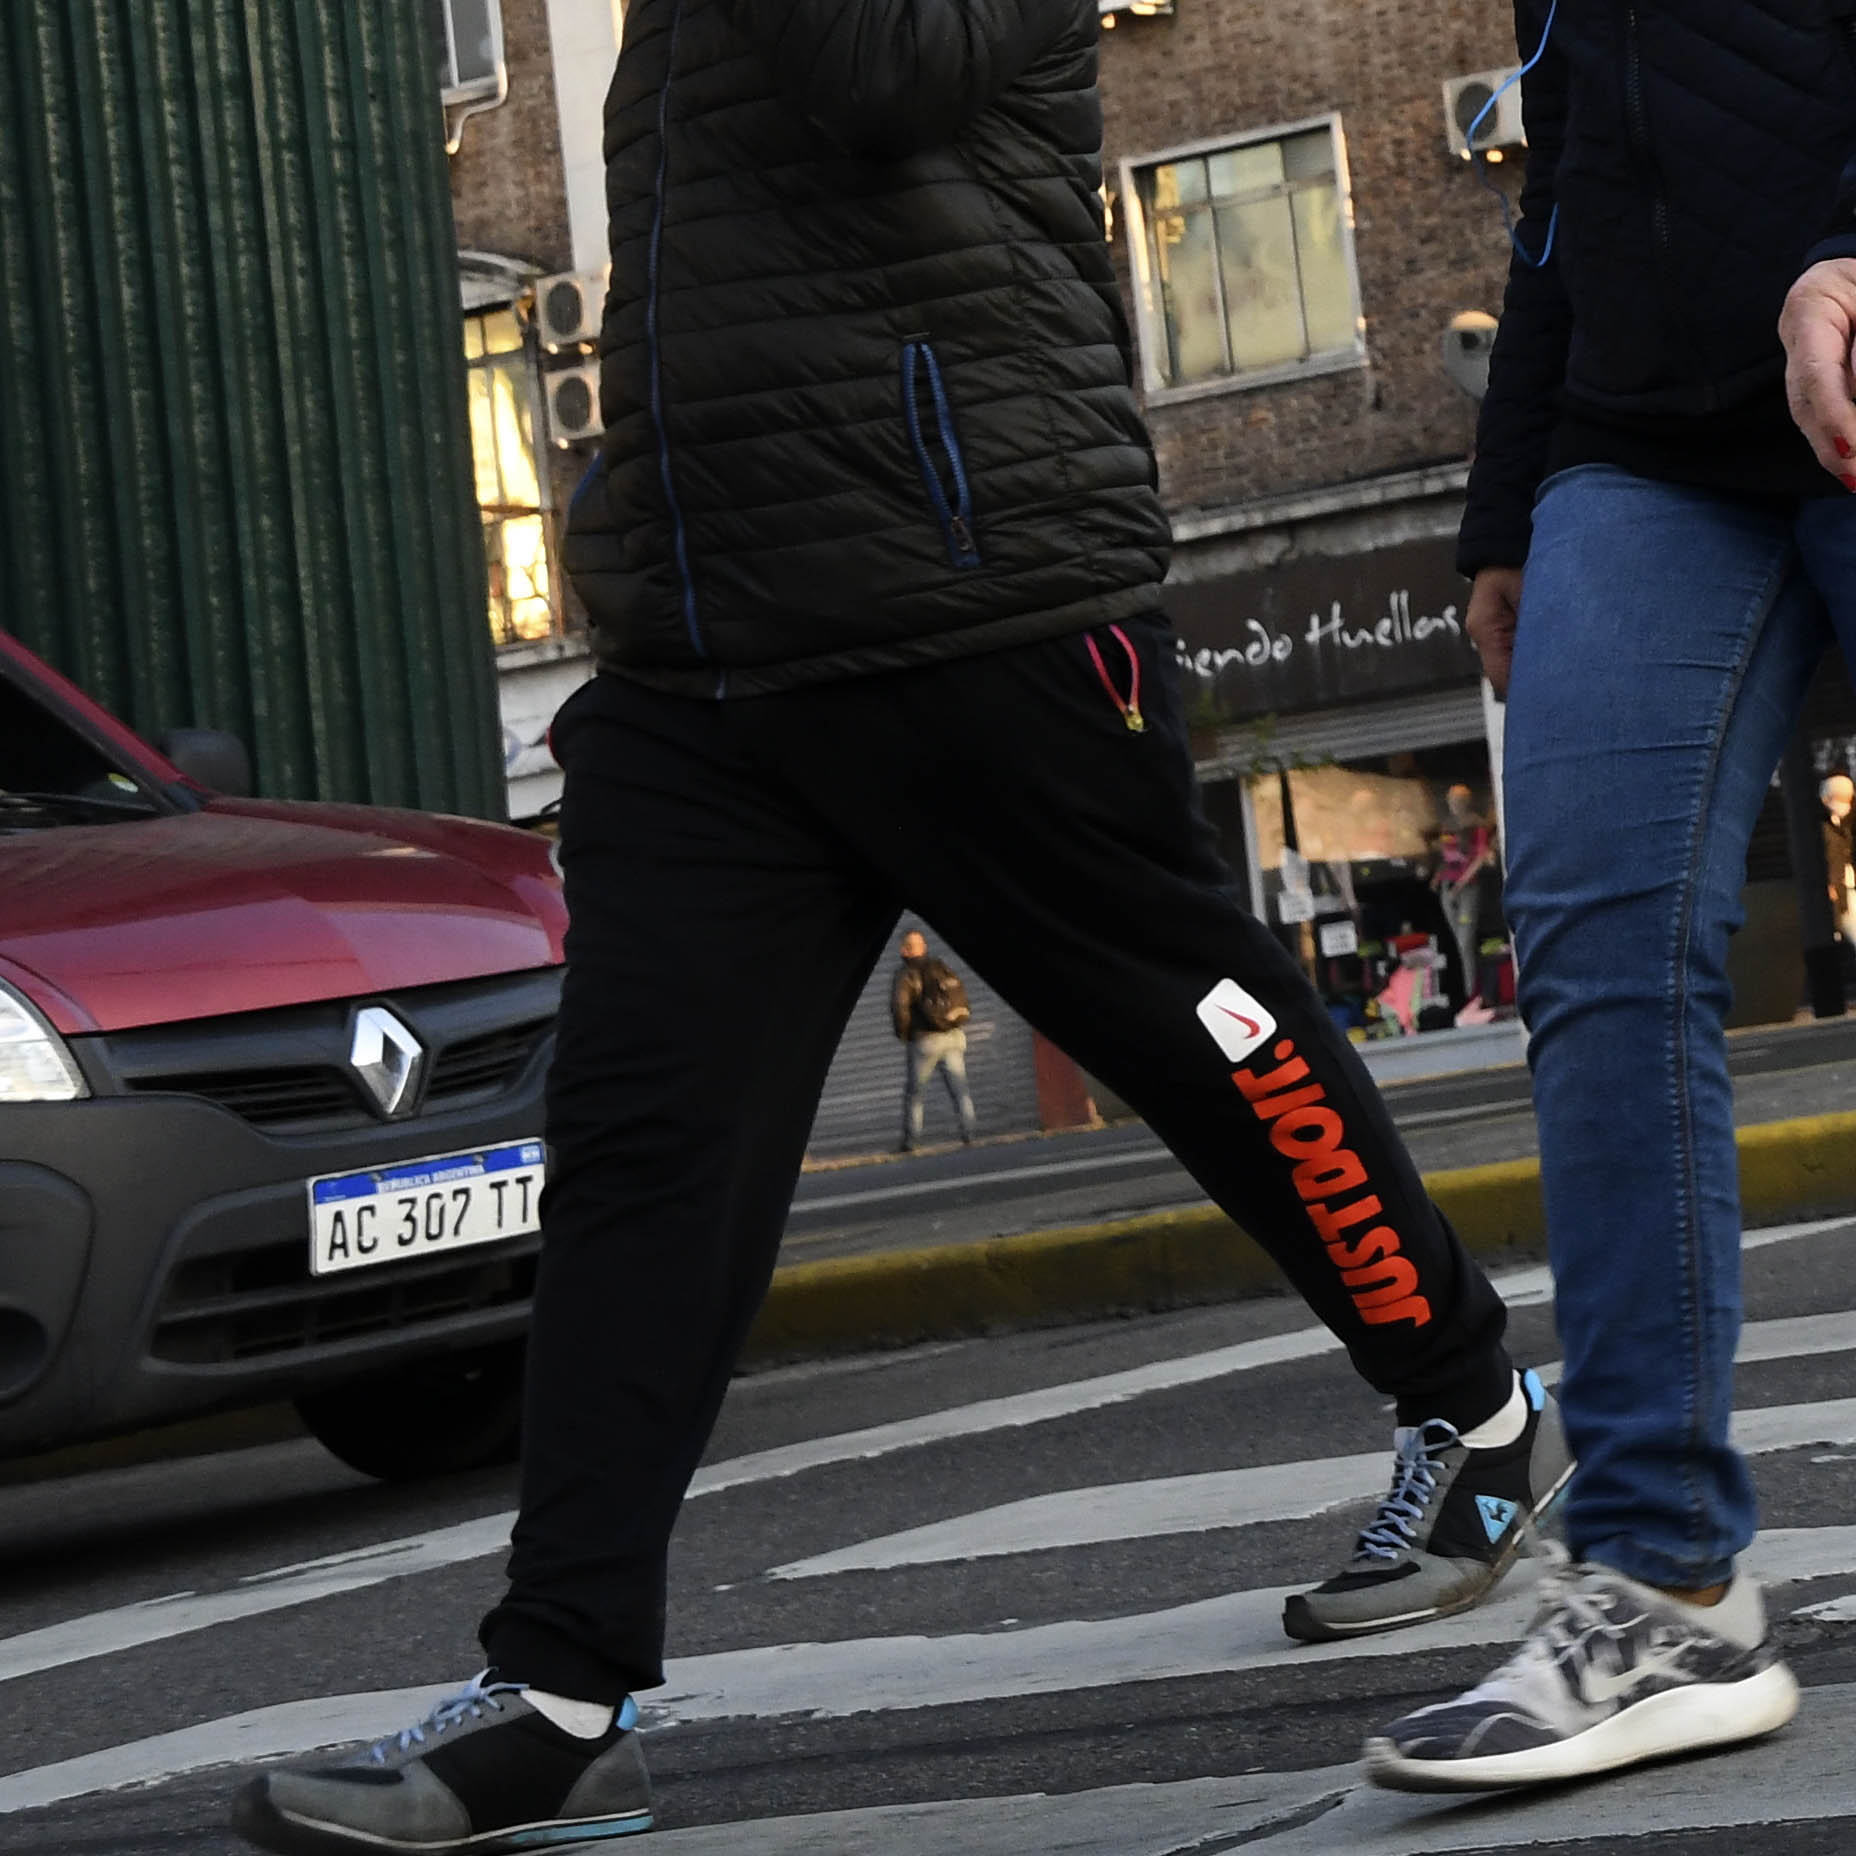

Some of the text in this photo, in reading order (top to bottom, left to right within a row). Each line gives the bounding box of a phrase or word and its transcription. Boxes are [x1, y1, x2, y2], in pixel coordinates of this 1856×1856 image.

[1174, 589, 1461, 678] iendo Huellas
[328, 1175, 534, 1261] AC 307 TT
